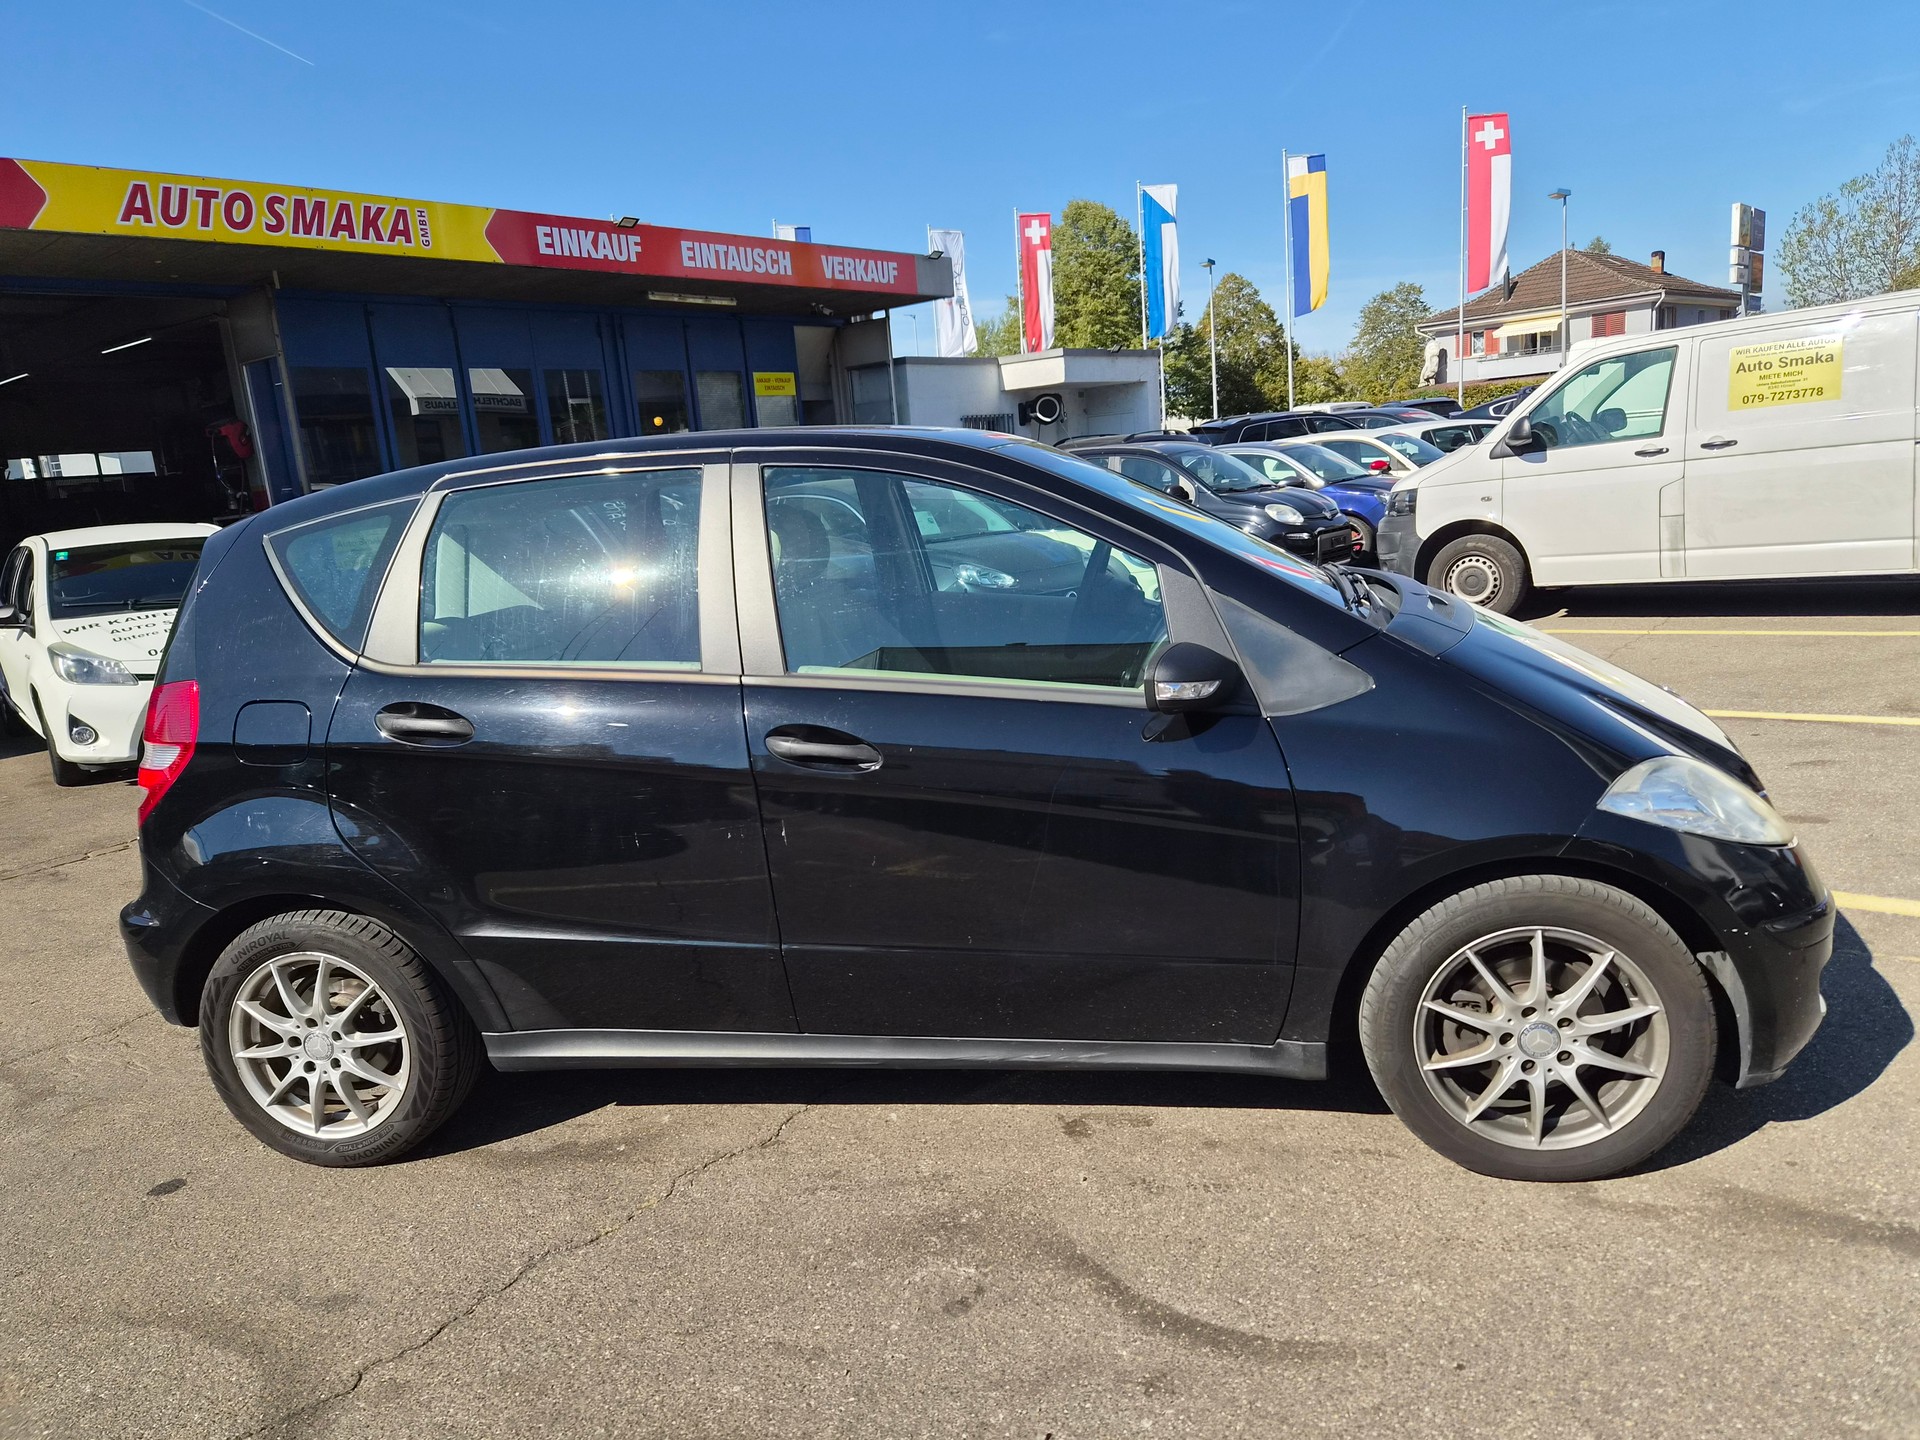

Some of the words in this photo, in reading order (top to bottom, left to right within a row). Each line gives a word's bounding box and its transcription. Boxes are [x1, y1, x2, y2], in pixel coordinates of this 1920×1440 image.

[119, 182, 255, 231] AUTO
[263, 194, 413, 245] SMAKA
[418, 207, 432, 249] GMBH
[536, 225, 642, 263] EINKAUF
[680, 240, 793, 277] EINTAUSCH
[821, 255, 899, 285] VERKAUF
[1735, 347, 1751, 356] WIR
[1752, 343, 1785, 354] KAUFEN
[1786, 340, 1807, 350] ALLE
[1736, 360, 1774, 374] Auto
[1778, 351, 1835, 369] Smaka
[1759, 372, 1782, 381] MIETE
[1783, 370, 1804, 378] MICH
[1742, 386, 1824, 405] 079-7273778
[62, 622, 102, 635] WIR
[108, 609, 178, 626] KAUFE
[110, 622, 157, 635] AUTO
[112, 630, 160, 643] Untere
[230, 931, 291, 965] UNIROYAL
[338, 1132, 402, 1163] UNIROYAL
